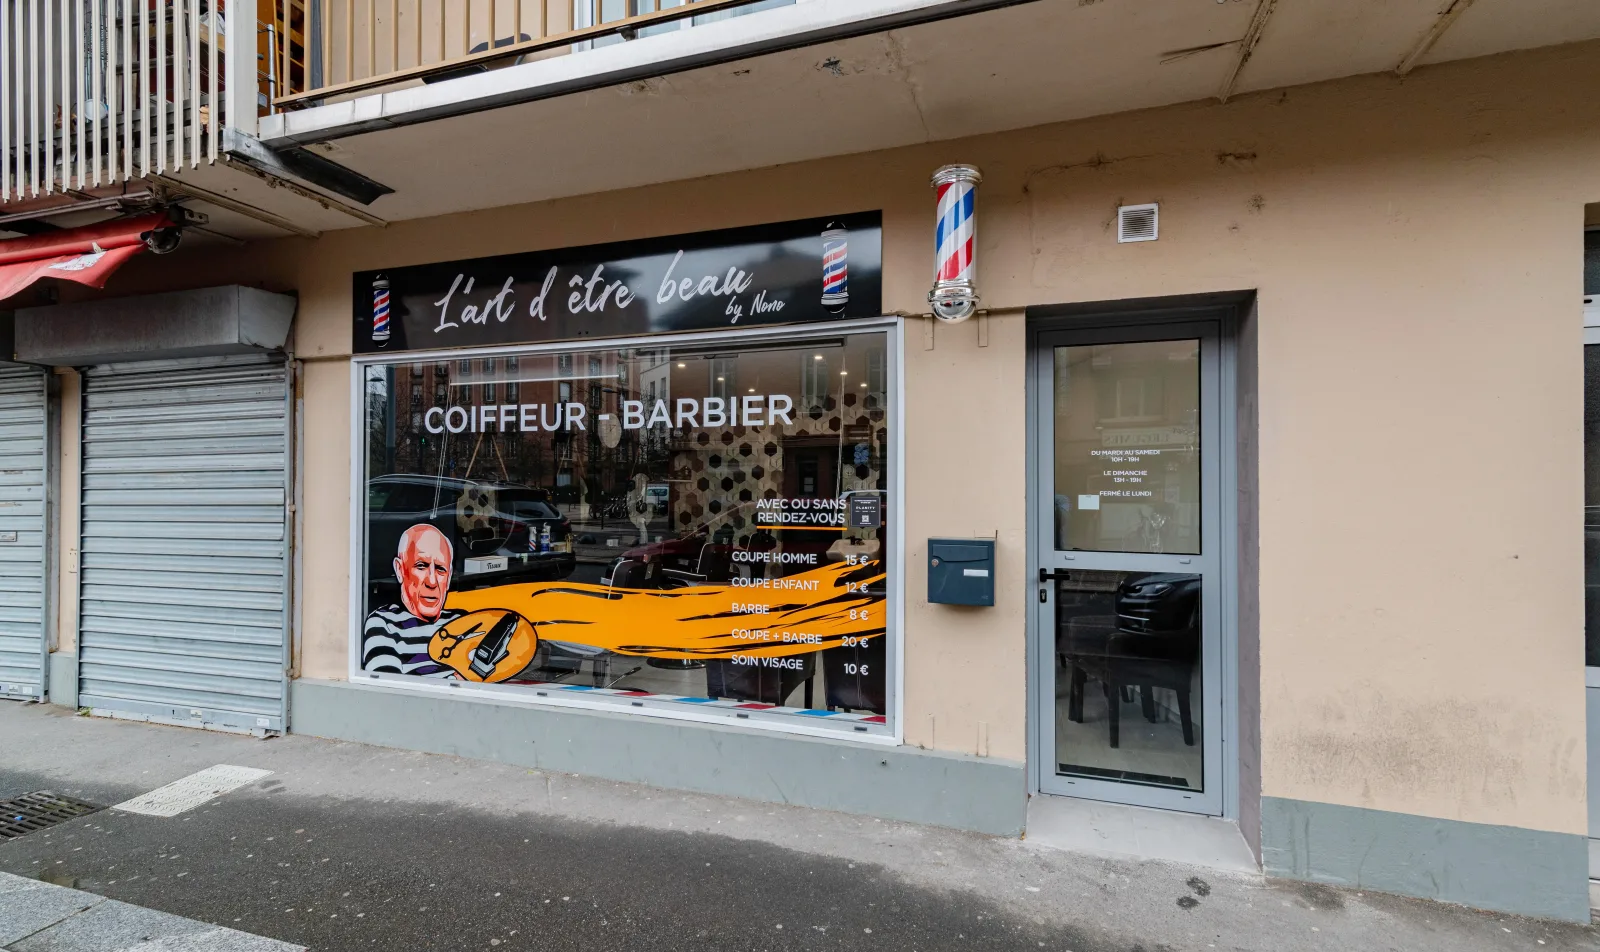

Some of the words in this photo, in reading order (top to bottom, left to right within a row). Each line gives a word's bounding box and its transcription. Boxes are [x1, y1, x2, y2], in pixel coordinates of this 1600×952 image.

[568, 263, 635, 314] être
[656, 249, 753, 305] beau
[725, 299, 743, 324] by
[749, 289, 785, 314] Nono
[424, 401, 586, 434] COIFFEUR
[623, 394, 794, 430] BARBIER
[756, 498, 789, 509] AVEC
[791, 498, 811, 509] OU
[812, 498, 847, 510] SANS
[757, 512, 846, 524] RENDEZ-VOUS
[731, 551, 770, 563] COUPE
[773, 552, 818, 565] HOMME
[845, 554, 857, 566] 15
[860, 555, 869, 566] €
[731, 577, 770, 589] COUPE
[773, 578, 820, 591] ENFANT
[845, 582, 857, 593] 12
[860, 582, 869, 594] €
[731, 603, 770, 615] BARBE
[850, 609, 857, 620] 8
[860, 609, 869, 621] €
[731, 628, 770, 641] COUPE
[782, 631, 823, 645] BARBE
[841, 636, 857, 648] 20
[860, 637, 869, 649] €
[731, 654, 759, 667] SOIN
[761, 656, 804, 670] VISAGE
[844, 663, 857, 675] 10
[860, 664, 869, 676] €
